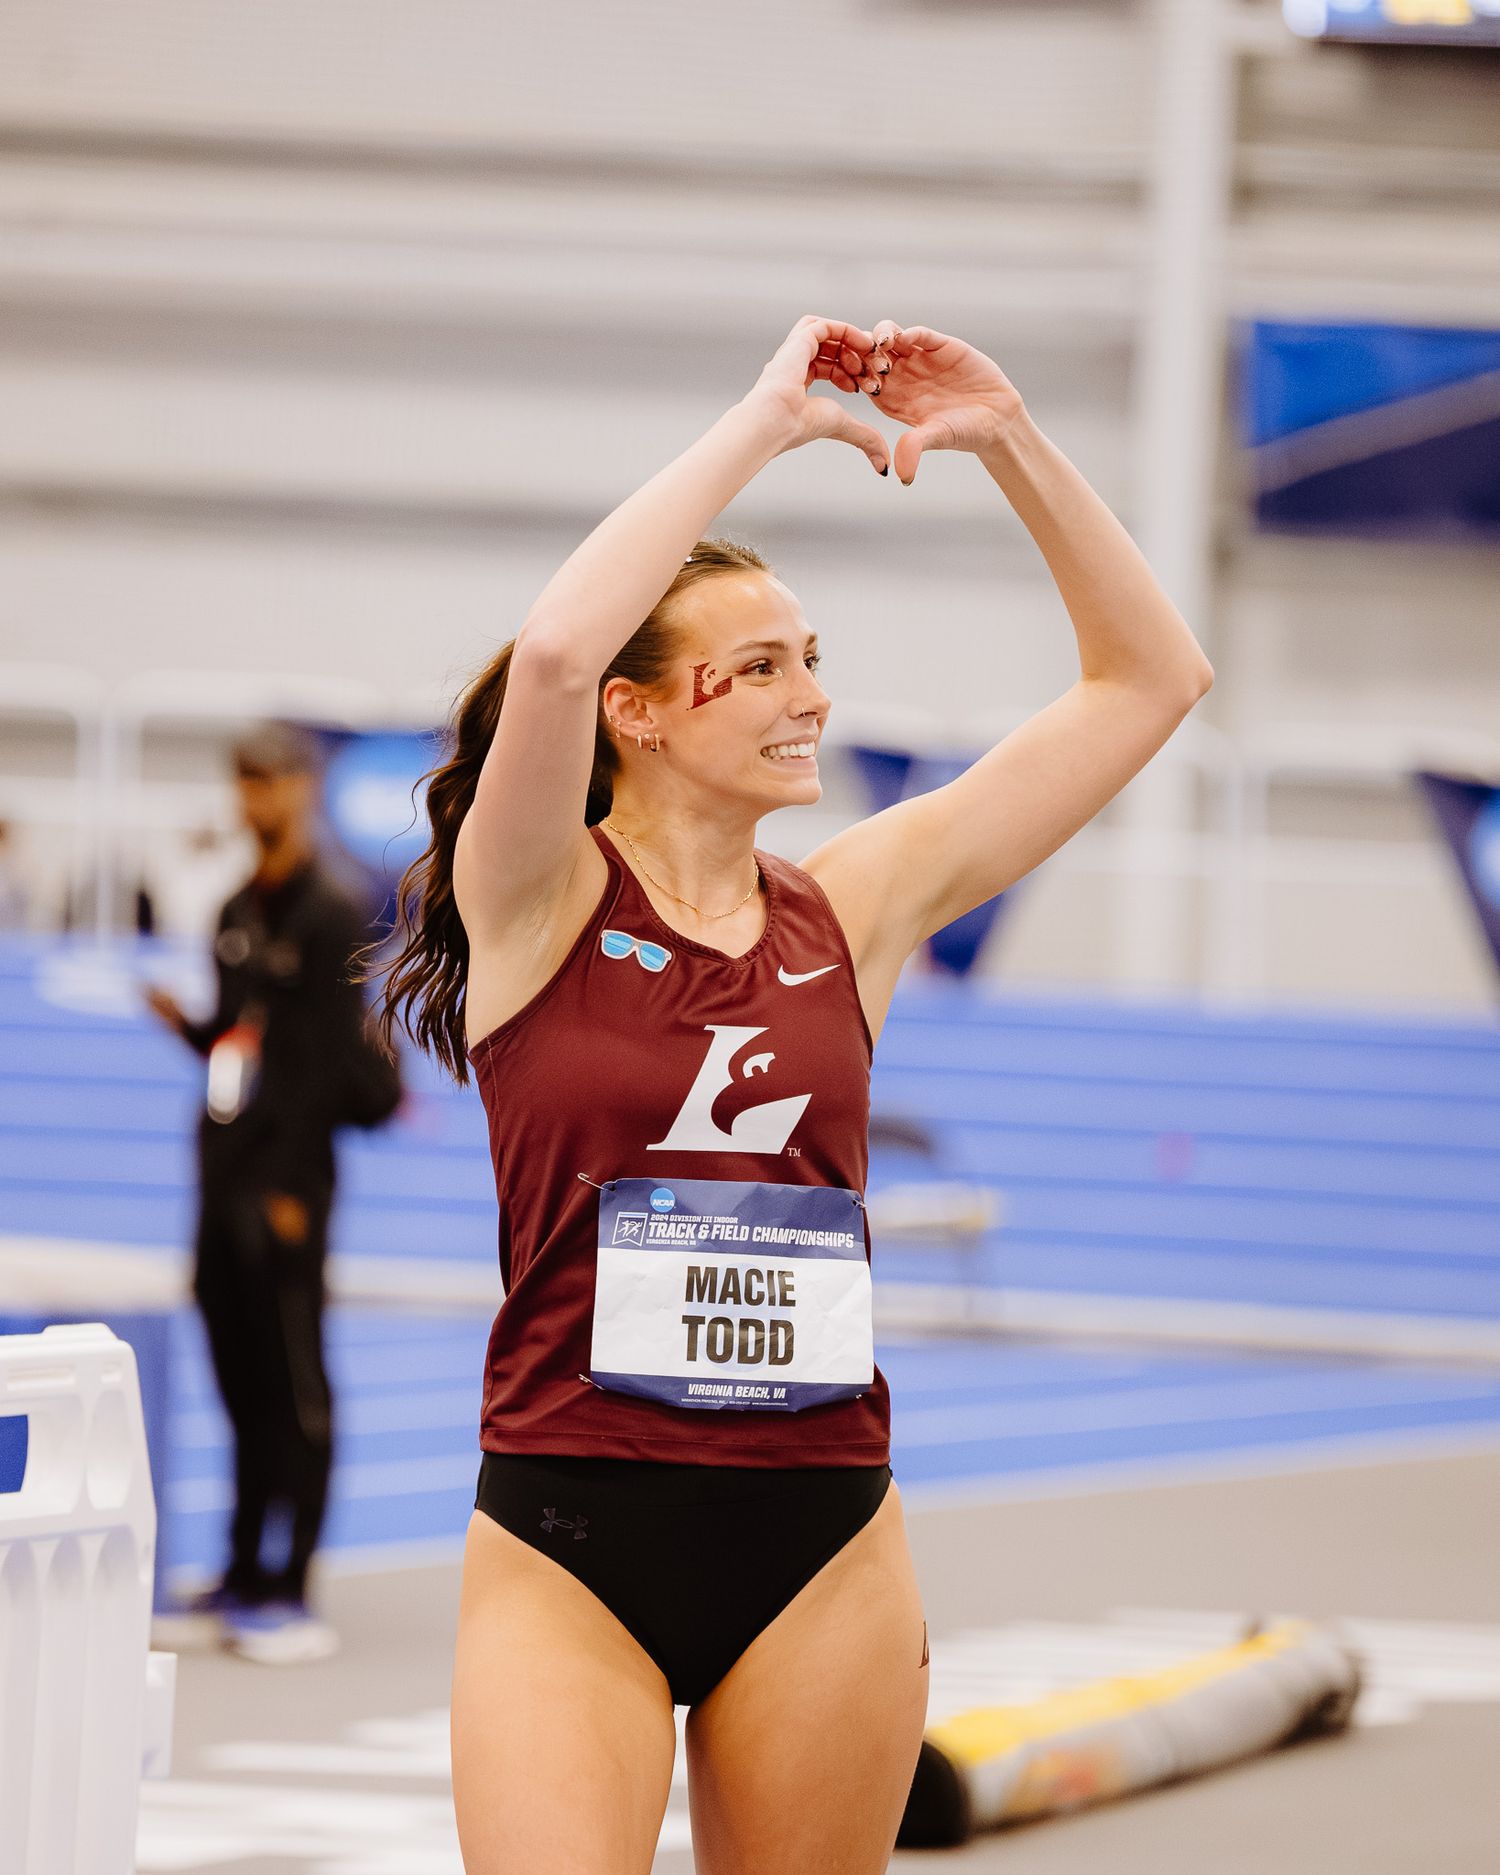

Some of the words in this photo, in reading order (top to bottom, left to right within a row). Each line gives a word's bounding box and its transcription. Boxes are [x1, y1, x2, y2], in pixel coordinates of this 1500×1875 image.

[787, 1147, 801, 1157] TM
[652, 1199, 675, 1207] NCAA
[669, 1215, 701, 1223] DIVISION
[713, 1216, 739, 1224] INDOOR
[648, 1222, 697, 1239] TRACK
[697, 1223, 710, 1240] &
[710, 1223, 750, 1242] FIELD
[752, 1226, 855, 1249] CHAMPIONSHIPS
[685, 1266, 796, 1307] MACIE
[682, 1315, 795, 1366] TODD
[687, 1383, 733, 1397] VIRGINIA
[735, 1386, 770, 1400] BEACH,
[773, 1387, 787, 1399] VA
